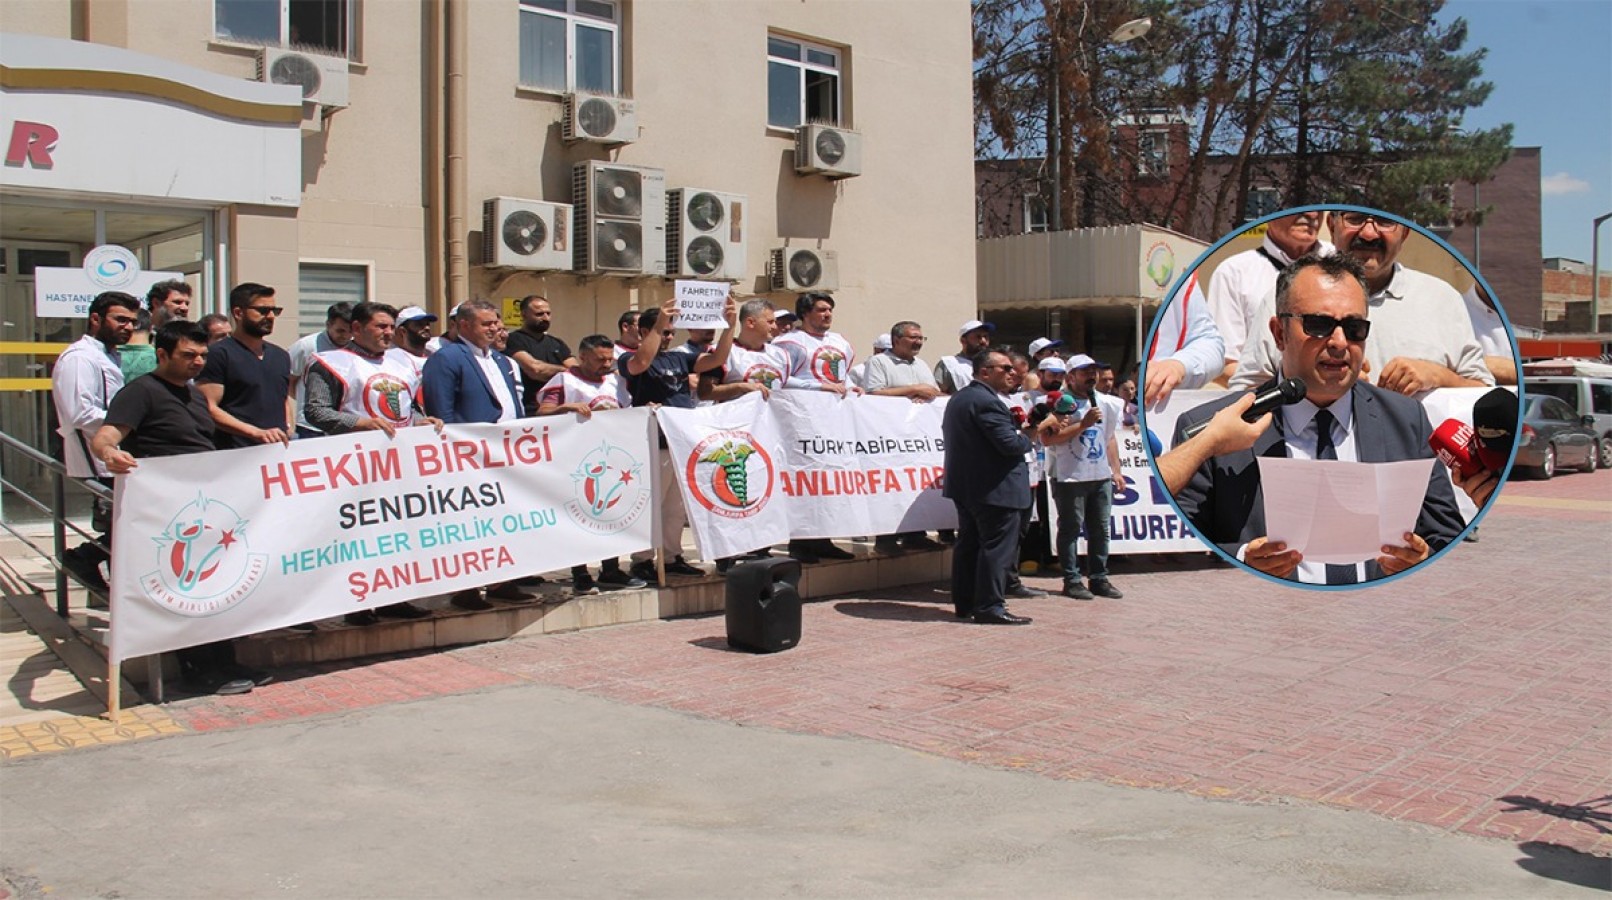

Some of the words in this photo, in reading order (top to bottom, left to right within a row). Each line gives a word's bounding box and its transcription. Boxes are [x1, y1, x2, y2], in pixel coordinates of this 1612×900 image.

[5, 120, 59, 169] R
[46, 294, 96, 303] HASTANE
[681, 300, 694, 309] BU
[261, 444, 402, 500] HEKİM
[415, 425, 553, 477] BİRLİĞİ
[798, 436, 844, 455] TÜRK
[844, 435, 932, 455] TABİPLERİ
[339, 481, 505, 530] SENDİKASI
[281, 532, 411, 575] HEKİMLER
[419, 516, 495, 549] BİRLİK
[501, 508, 557, 534] OLDU
[347, 546, 515, 603] ŞANLIURFA
